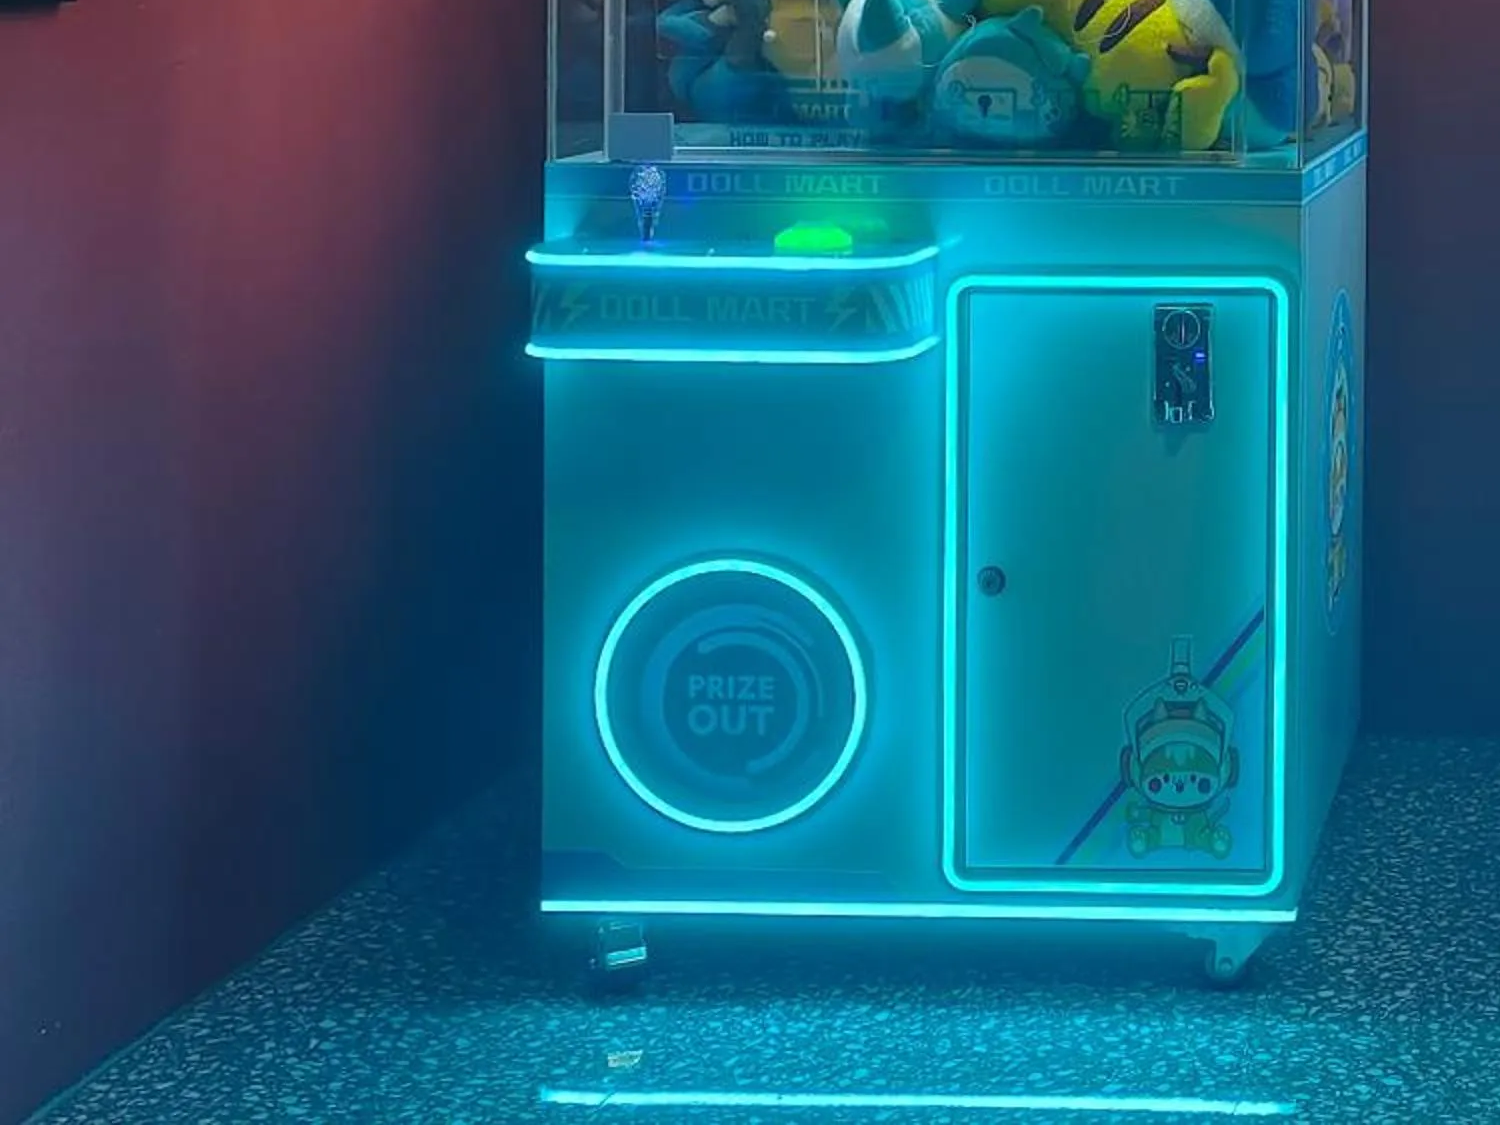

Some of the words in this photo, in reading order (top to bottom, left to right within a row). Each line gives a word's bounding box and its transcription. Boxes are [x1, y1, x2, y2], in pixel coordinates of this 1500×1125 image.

[730, 130, 769, 147] HOW
[777, 132, 802, 147] TO
[810, 131, 863, 147] PLAY
[686, 172, 774, 194] DOLL
[784, 172, 888, 194] MART
[985, 175, 1069, 195] DOLL
[1083, 176, 1186, 196] MART
[600, 294, 697, 322] DOLL
[705, 295, 815, 325] MART
[688, 676, 774, 700] PRIZE
[688, 706, 773, 736] OUT
